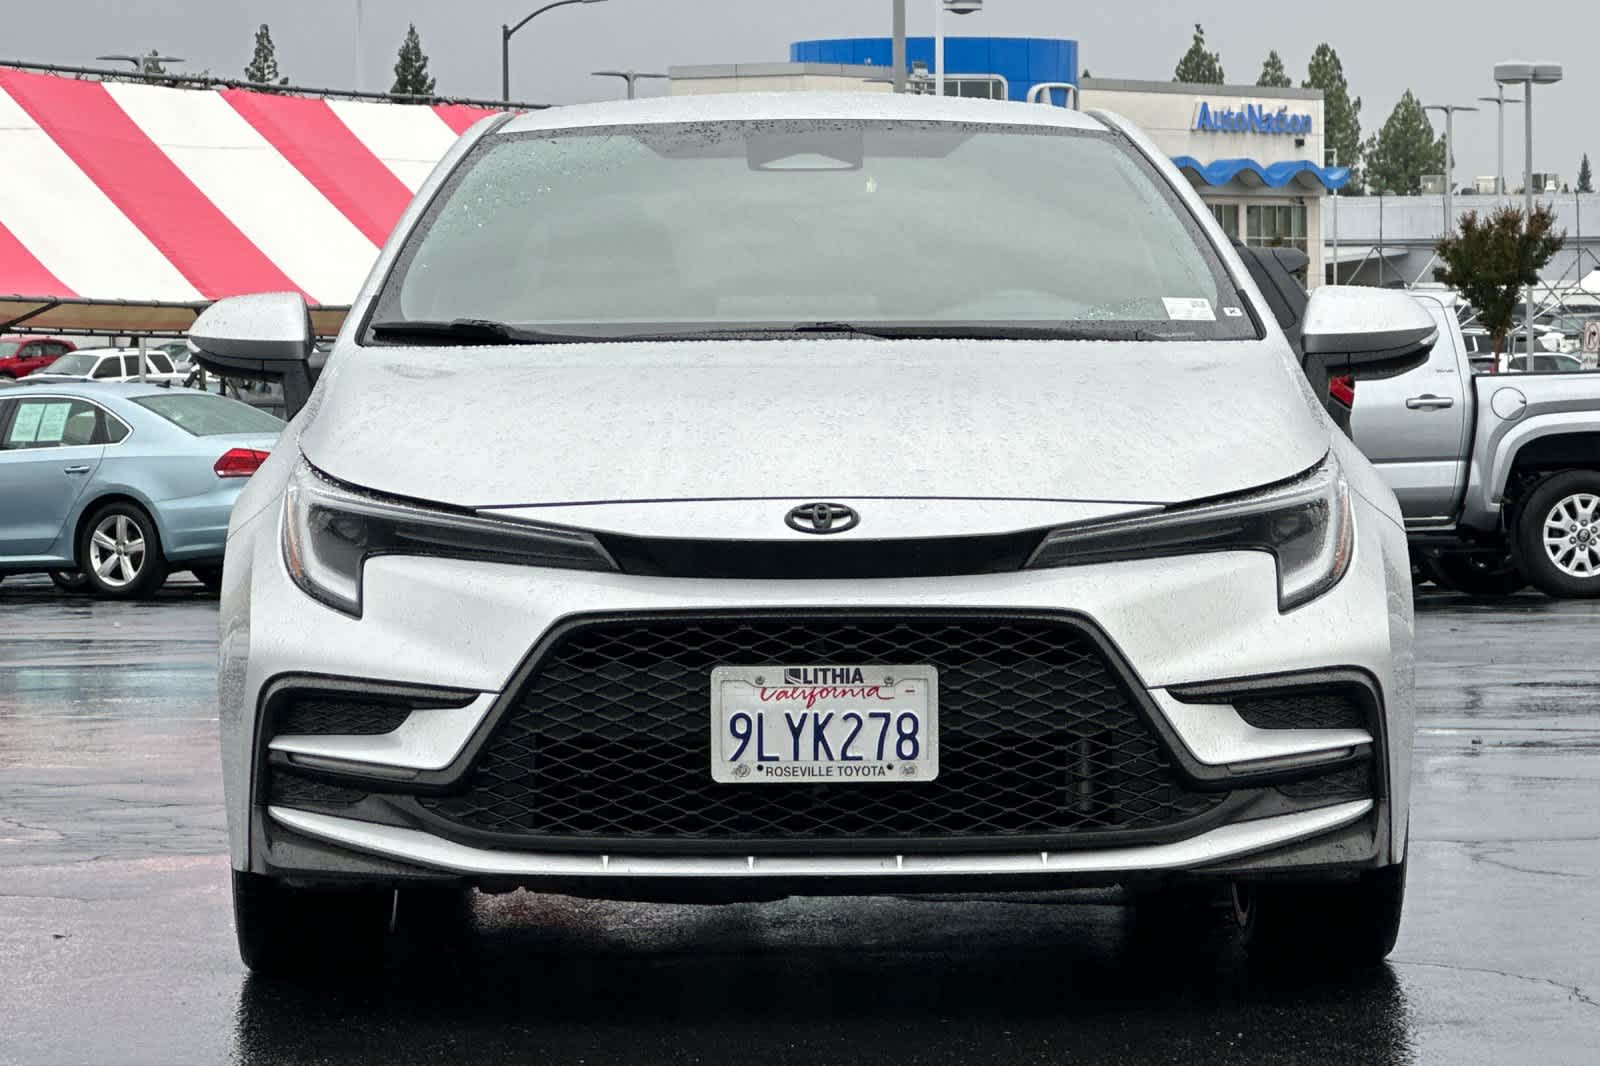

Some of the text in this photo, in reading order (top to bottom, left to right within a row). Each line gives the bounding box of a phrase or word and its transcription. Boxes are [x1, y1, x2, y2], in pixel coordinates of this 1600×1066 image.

[1196, 101, 1312, 135] AutoNation
[802, 667, 864, 685] LITHIA
[760, 685, 895, 709] California
[729, 712, 920, 762] 9LYK278
[765, 764, 886, 777] ROSEVILLE TOYOTA
